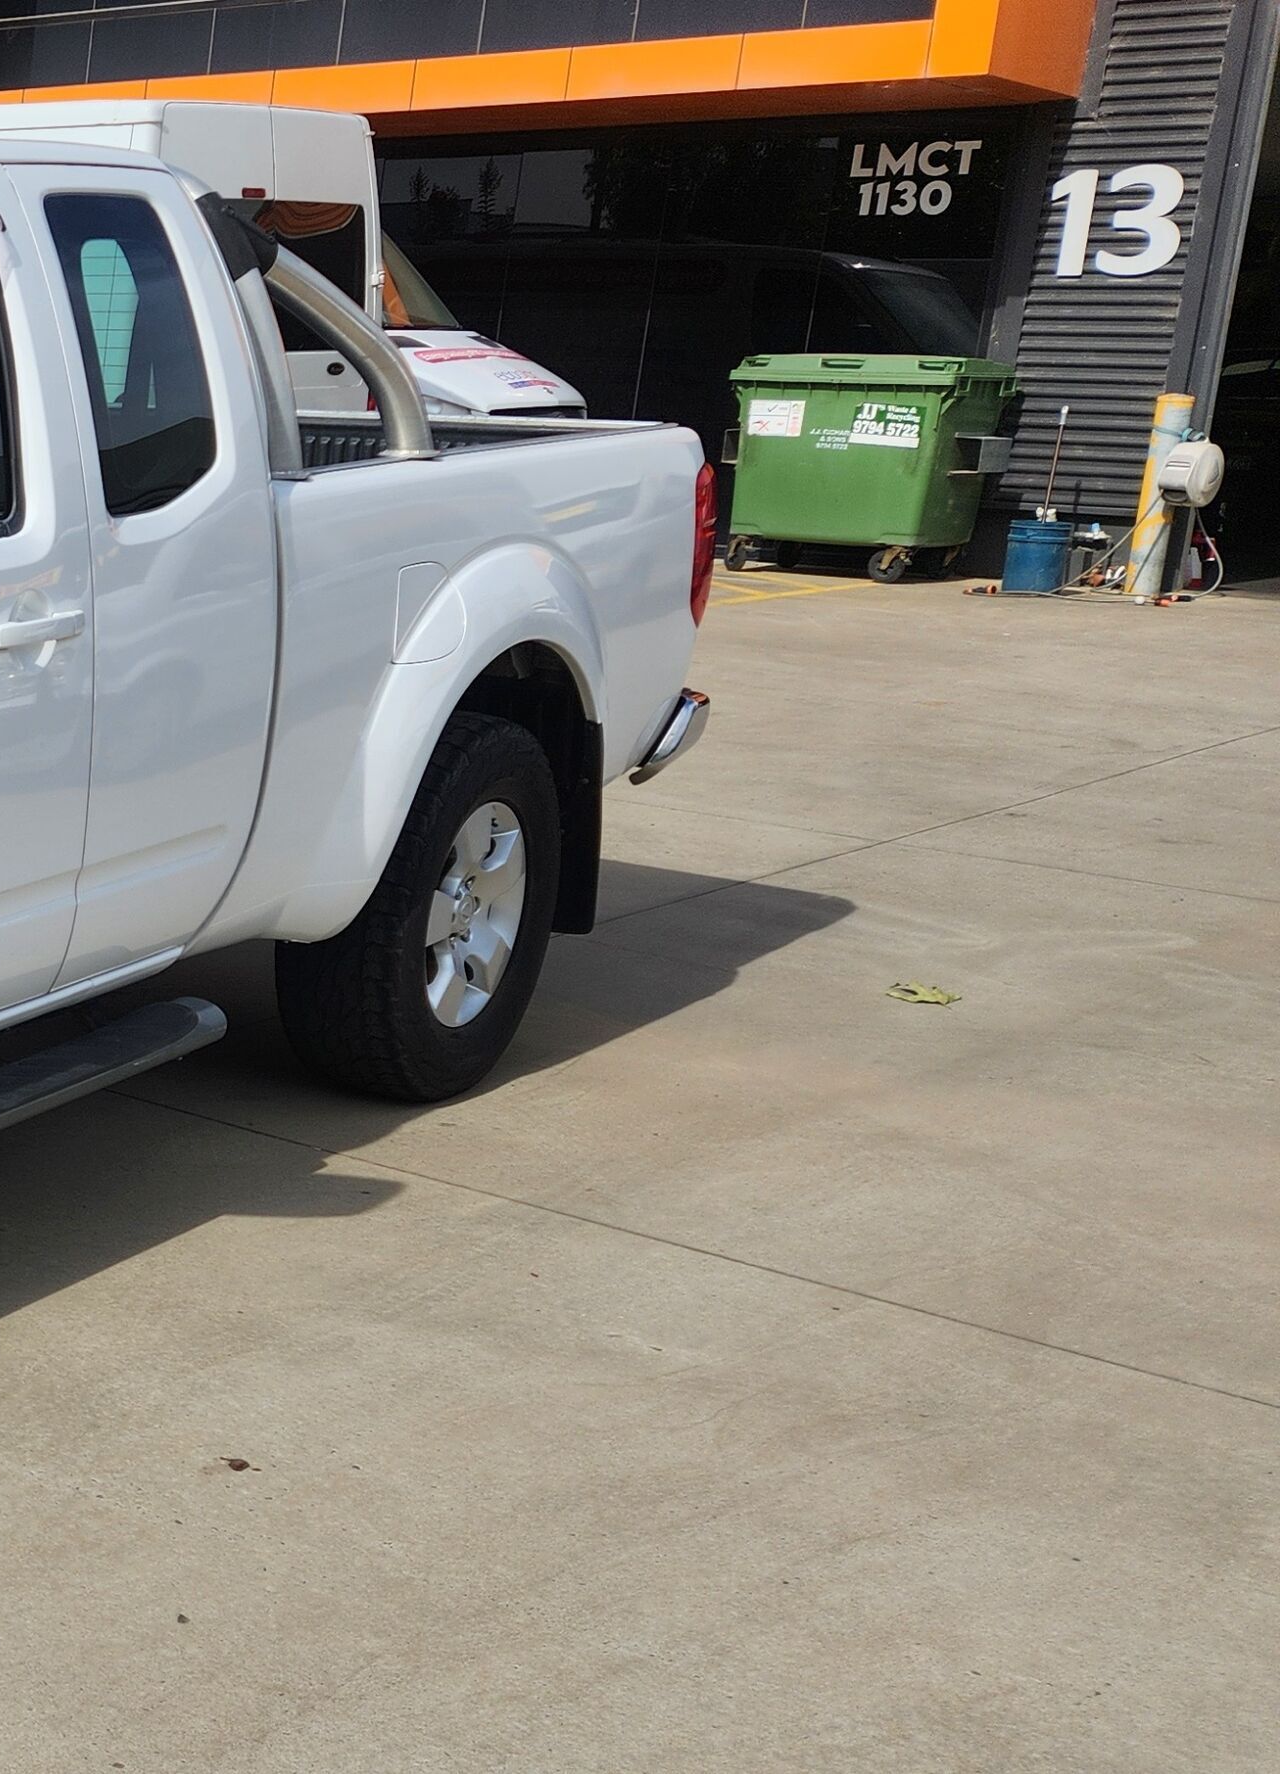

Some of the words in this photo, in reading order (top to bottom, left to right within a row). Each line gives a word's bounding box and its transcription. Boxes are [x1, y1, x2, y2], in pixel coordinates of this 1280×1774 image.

[850, 140, 982, 177] LMCT
[858, 180, 953, 216] 1130
[1051, 164, 1184, 278] 13
[852, 420, 885, 435] 9794
[885, 422, 920, 438] 5722
